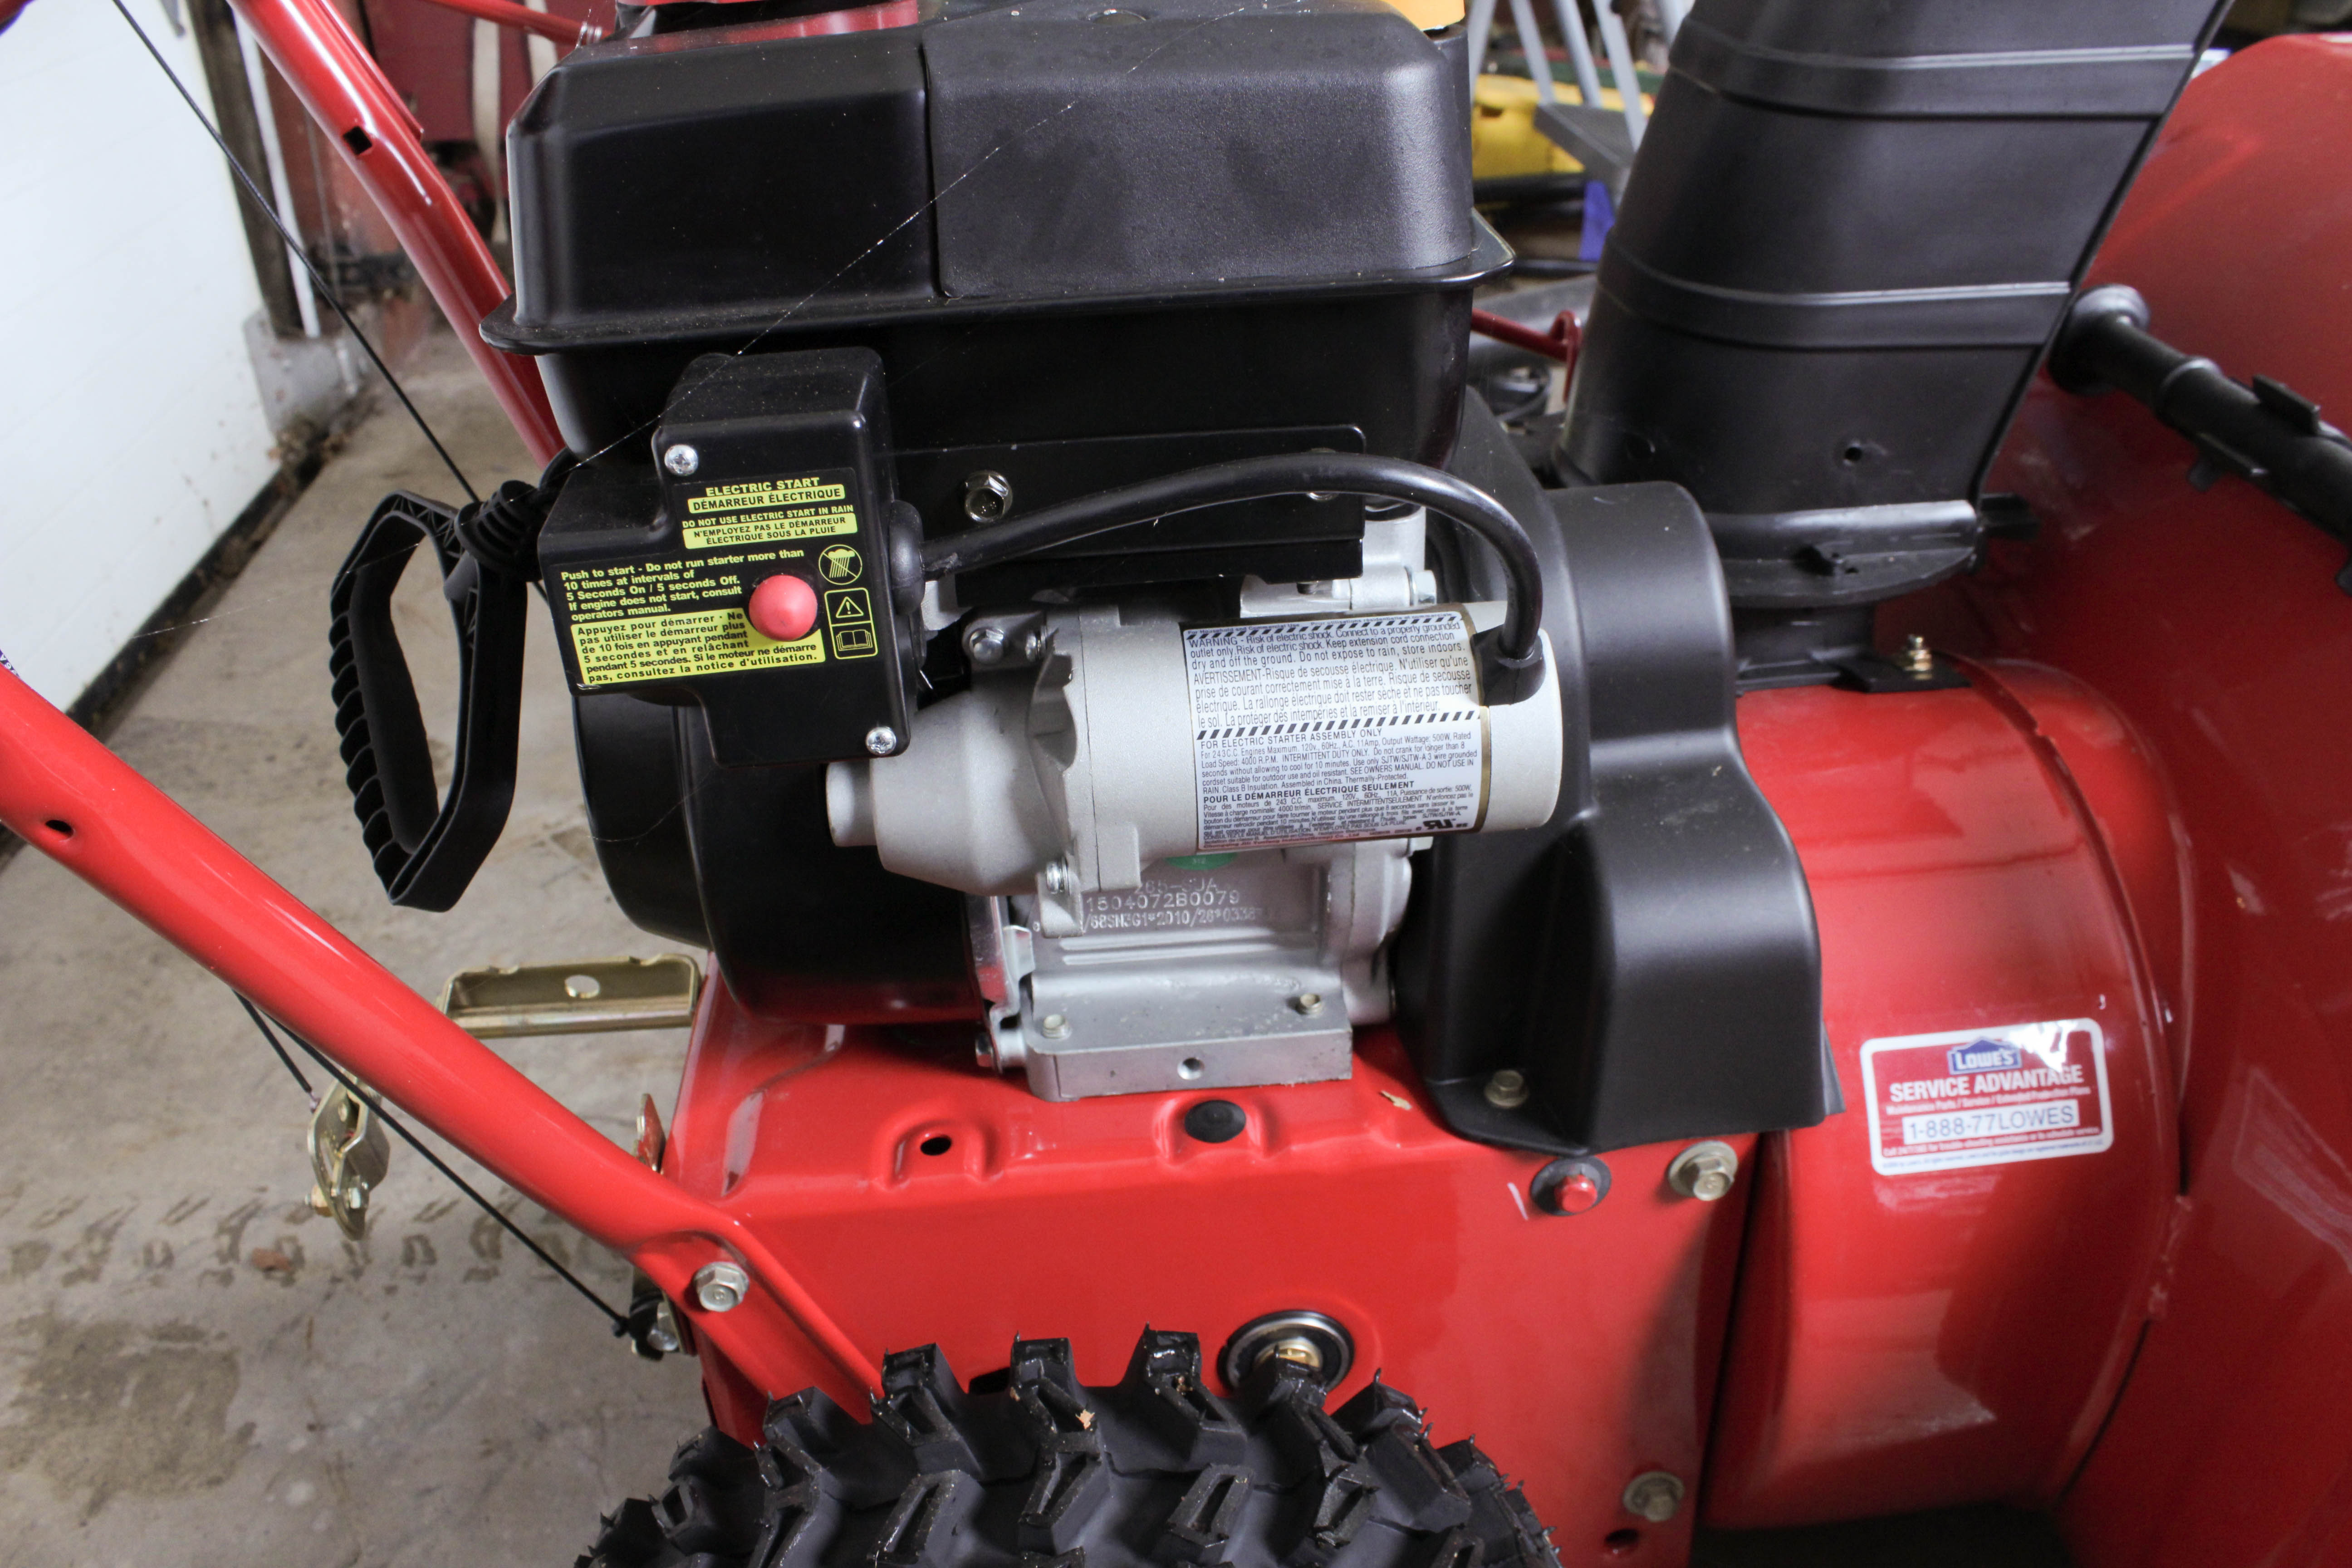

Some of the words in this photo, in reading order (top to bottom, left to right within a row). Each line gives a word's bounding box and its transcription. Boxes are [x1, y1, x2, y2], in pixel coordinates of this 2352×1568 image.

[693, 493, 764, 511] DÉMARREUR
[768, 485, 841, 505] ÉLECTRIQUE
[706, 481, 772, 497] ELECTRIC
[776, 477, 819, 490] START
[682, 520, 695, 529] DO
[698, 518, 717, 527] NOT
[719, 516, 738, 525] USE
[740, 511, 784, 523] ELECTRIC
[787, 509, 816, 519] START
[818, 507, 828, 516] IN
[831, 505, 853, 514] RAIN
[694, 525, 750, 538] N'EMPLOYEZ
[754, 524, 771, 532] PAS
[789, 514, 845, 529] DÉMARREUR
[706, 530, 763, 545] ÉLECTRIQUE
[767, 529, 791, 539] SOUS
[795, 528, 806, 536] LA
[809, 525, 835, 535] PLUIE
[561, 570, 589, 582] Push
[592, 568, 604, 578] to
[607, 565, 635, 577] start
[646, 563, 662, 573] Do
[664, 561, 683, 571] not
[686, 560, 704, 569] run
[707, 554, 745, 567] starter
[748, 553, 776, 563] more
[779, 549, 804, 560] than
[564, 581, 578, 591] 10
[581, 577, 613, 589] times
[616, 576, 628, 586] at
[631, 571, 680, 584] intervals
[682, 569, 695, 579] of
[566, 592, 574, 601] 5
[577, 587, 626, 600] Seconds
[629, 584, 646, 595] On
[657, 583, 665, 592] 5
[668, 578, 716, 591] seconds
[720, 575, 740, 586] Off.
[568, 602, 577, 612] If
[580, 598, 617, 612] engine
[619, 595, 646, 607] does
[648, 593, 667, 603] not
[669, 589, 699, 603] start,
[701, 585, 742, 598] consult
[571, 607, 624, 622] operators
[627, 603, 671, 616] manual.
[577, 622, 626, 637] Appuyez
[631, 621, 657, 632] pour
[660, 613, 715, 627] démarrer
[727, 611, 742, 621] Ne
[579, 637, 600, 647] pas
[603, 631, 642, 642] utiliser
[646, 629, 656, 638] le
[660, 623, 718, 637] démarreur
[722, 620, 745, 632] plus
[581, 644, 595, 654] de
[599, 643, 612, 652] 10
[614, 641, 634, 651] fois
[637, 641, 650, 649] en
[652, 634, 701, 648] appuyant
[704, 629, 747, 643] pendant
[1189, 636, 1238, 648] WARNING
[1246, 634, 1264, 644] Risk
[1266, 633, 1274, 643] of
[1276, 631, 1307, 642] electric
[1308, 629, 1333, 640] shock.
[1335, 627, 1368, 638] Connect
[1369, 626, 1378, 636] to
[1387, 623, 1420, 636] properly
[1422, 621, 1460, 634] grounded
[1190, 647, 1214, 658] outlet
[1256, 644, 1264, 653] of
[1266, 641, 1297, 653] electric
[1326, 638, 1347, 650] Keep
[1349, 635, 1388, 647] extension
[1390, 633, 1408, 644] cord
[1410, 630, 1454, 642] connection
[584, 654, 590, 663] 5
[595, 648, 651, 662] secondes
[656, 647, 668, 656] et
[691, 638, 749, 652] relâchant
[586, 660, 628, 674] pendant
[630, 659, 637, 668] 5
[639, 654, 691, 667] secondes.
[693, 653, 703, 662] Si
[706, 652, 715, 661] le
[718, 647, 755, 660] moteur
[772, 642, 816, 654] démarre
[1191, 658, 1206, 672] dry
[1209, 657, 1225, 669] and
[1229, 656, 1240, 667] off
[1243, 655, 1257, 666] the
[1260, 652, 1295, 667] ground.
[1299, 651, 1311, 662] Do
[1314, 650, 1328, 661] not
[1332, 650, 1363, 662] expose
[1366, 647, 1375, 658] to
[1378, 645, 1399, 658] rain,
[1402, 643, 1425, 655] store
[1428, 641, 1465, 653] indoors.
[588, 673, 612, 684] pas,
[616, 666, 675, 680] consultez
[680, 664, 691, 673] la
[696, 660, 734, 672] notice
[740, 652, 817, 667] d'utilisation.
[1297, 664, 1308, 677] de
[1310, 664, 1348, 676] secousse
[1352, 658, 1396, 676] électrique.
[1399, 655, 1437, 670] N'utiliser
[1440, 652, 1468, 670] qu'une
[1195, 685, 1216, 702] prise
[1218, 684, 1229, 698] de
[1231, 682, 1263, 697] courant
[1265, 677, 1320, 694] correctement
[1323, 676, 1343, 690] mise
[1345, 675, 1350, 688] à
[1353, 675, 1361, 688] la
[1363, 673, 1385, 687] terre.
[1388, 671, 1417, 687] Risque
[1420, 670, 1430, 683] de
[1432, 669, 1470, 682] secousse
[1201, 740, 1218, 750] FOR
[1222, 736, 1264, 748] ELECTRIC
[1268, 733, 1306, 745] STARTER
[1310, 730, 1356, 741] ASSEMBLY
[1360, 727, 1382, 738] ONLY
[1204, 795, 1228, 804] POUR
[1232, 794, 1242, 802] LE
[1245, 787, 1300, 801] DÉMARREUR
[1304, 783, 1359, 797] ÉLECTRIQUE
[1362, 780, 1414, 792] SEULEMENT
[1222, 784, 1239, 793] Class
[1281, 779, 1314, 789] Assembled
[1890, 1076, 1970, 1102] SERVICE
[1974, 1064, 2084, 1093] ADVANTAGE
[1909, 1105, 2073, 1139] 1-888-77LOWES
